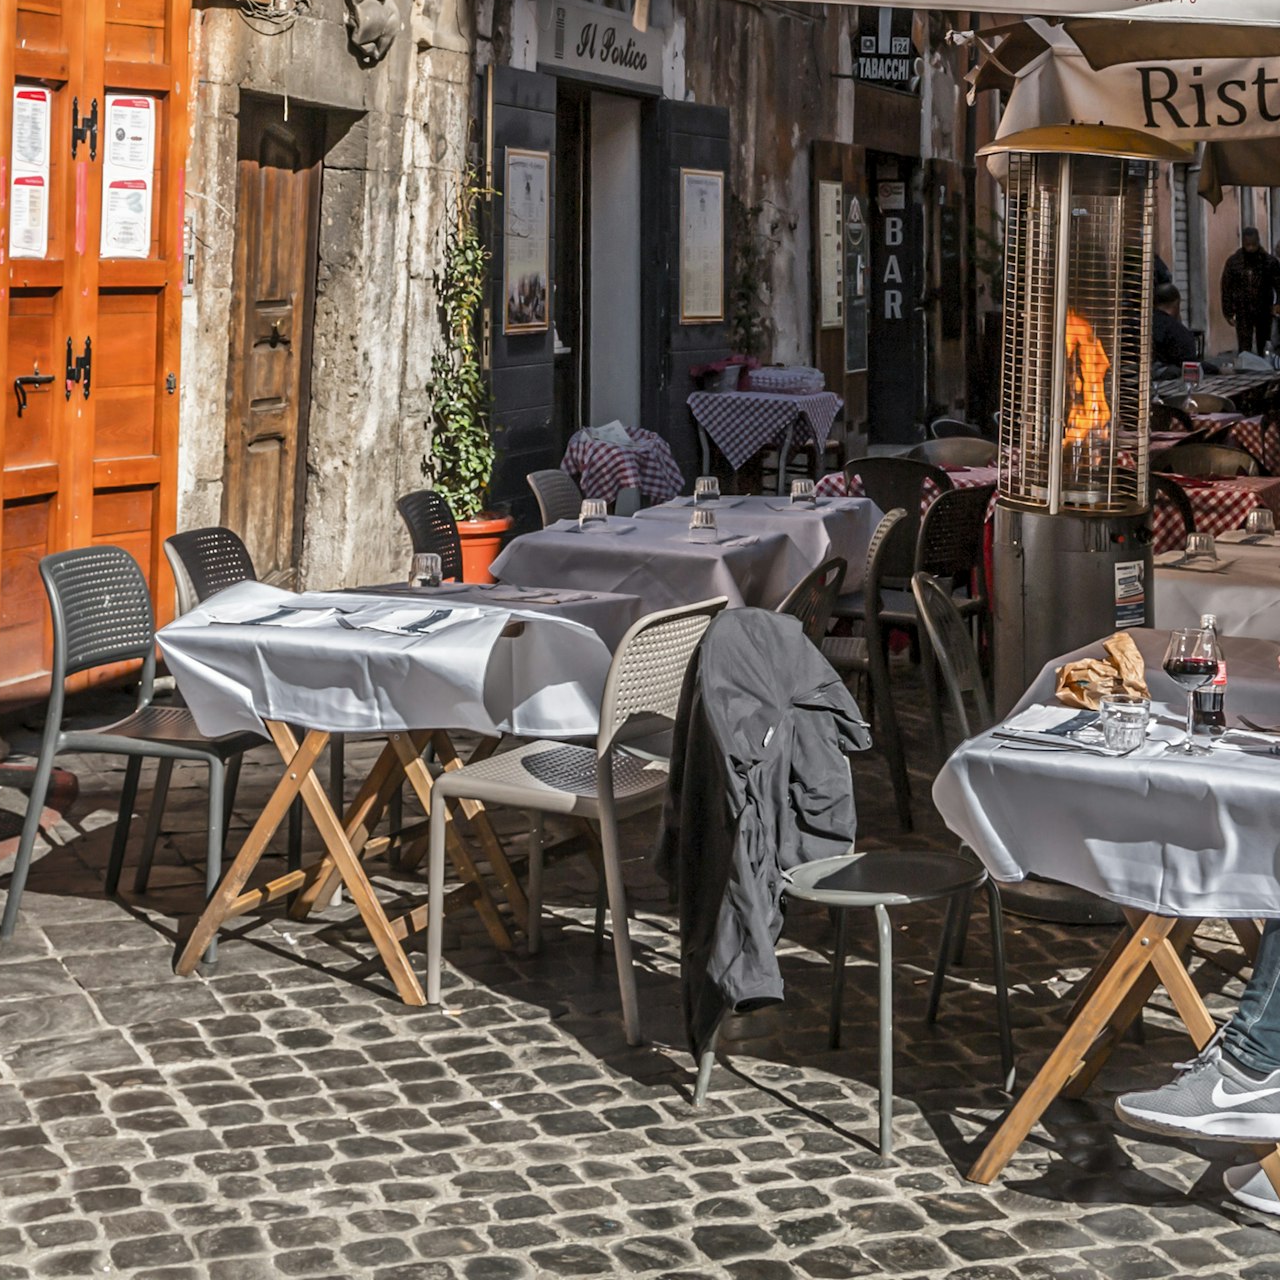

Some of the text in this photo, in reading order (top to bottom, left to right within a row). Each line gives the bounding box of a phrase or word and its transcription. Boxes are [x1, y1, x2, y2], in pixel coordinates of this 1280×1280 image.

[576, 23, 648, 71] Il Portico
[893, 43, 908, 53] 124
[859, 57, 910, 81] TABACCHI
[883, 217, 904, 319] BAR
